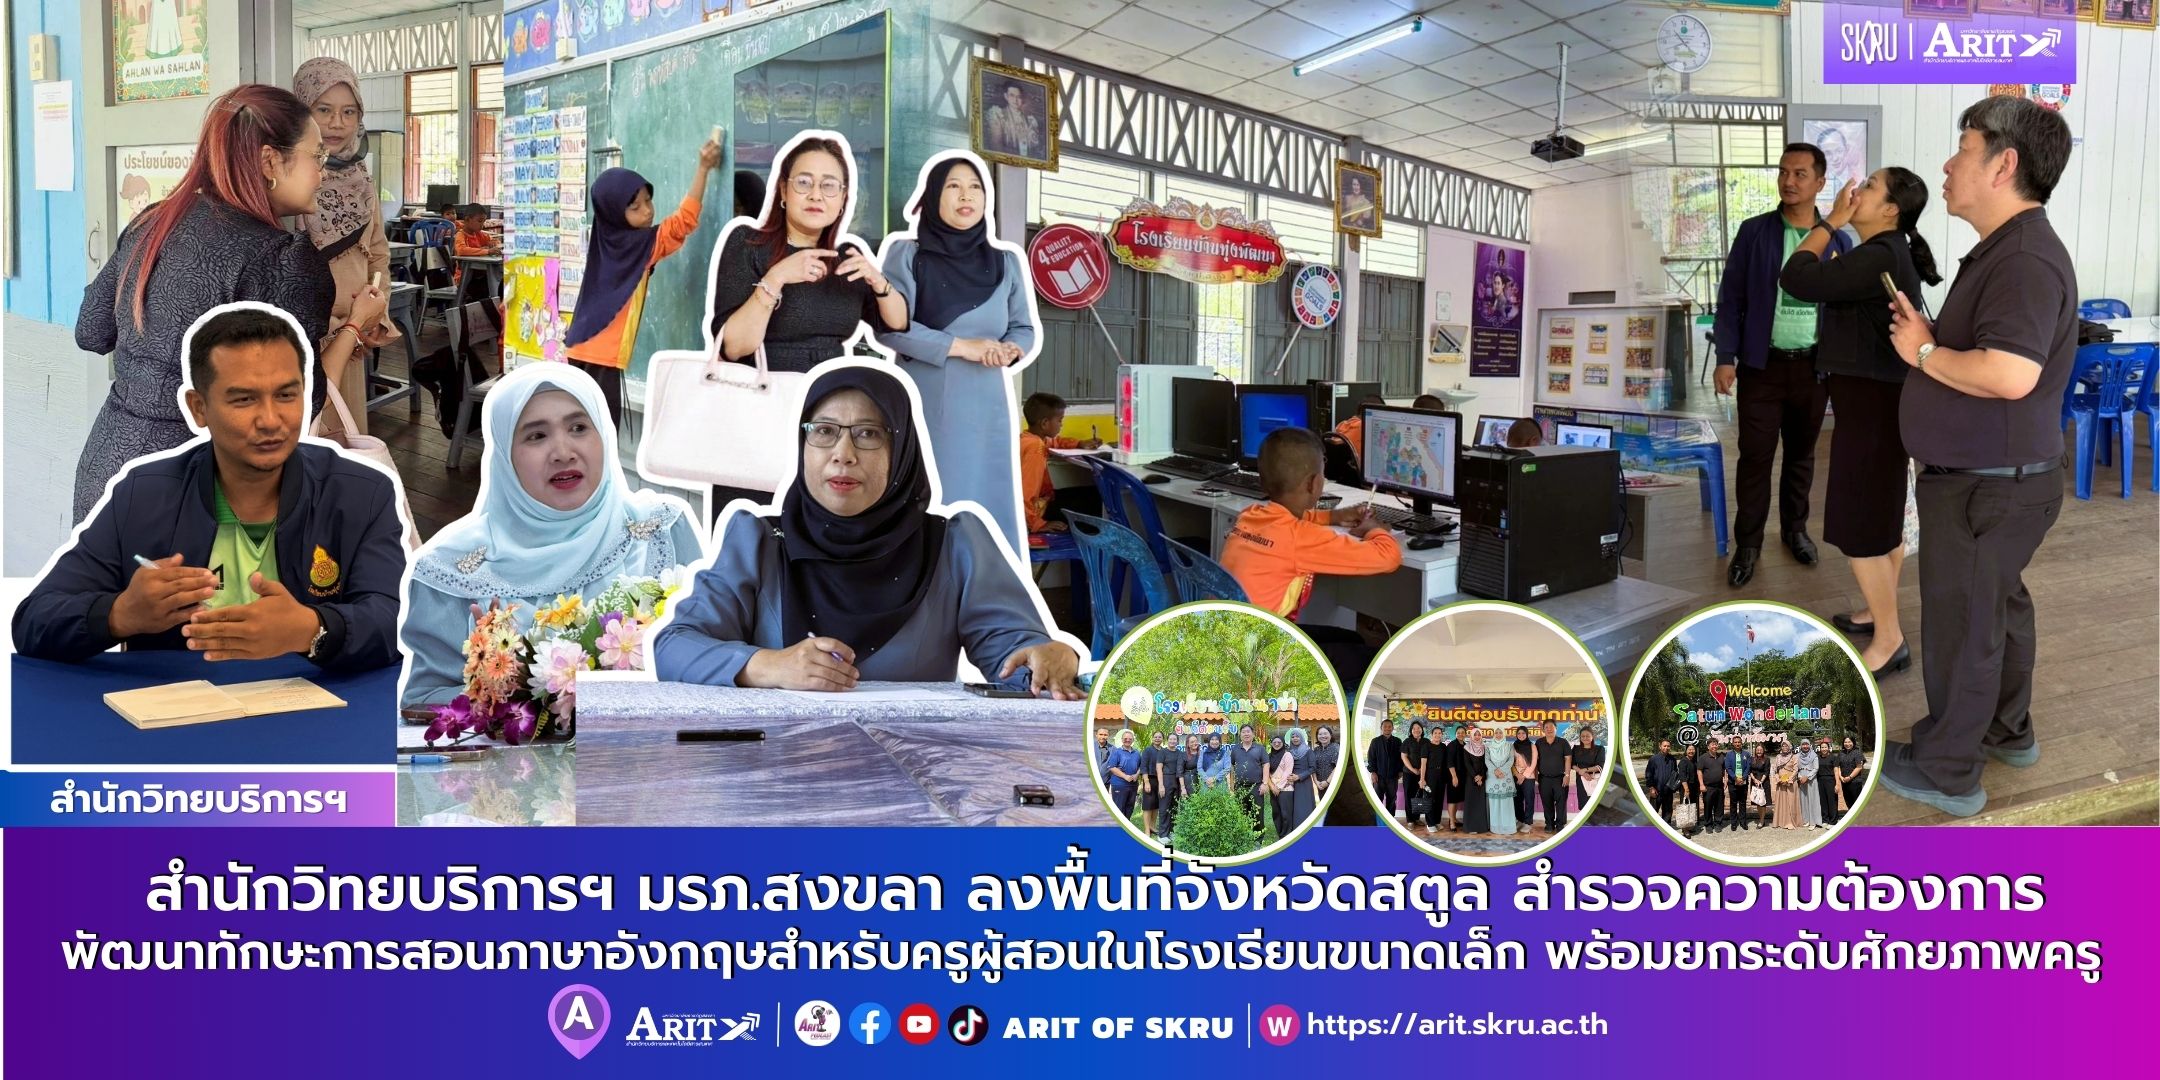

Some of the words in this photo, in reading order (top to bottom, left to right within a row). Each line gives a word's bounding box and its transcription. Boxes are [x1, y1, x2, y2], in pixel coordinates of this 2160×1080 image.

[125, 66, 151, 78] AHLAN
[153, 65, 165, 75] WA
[167, 60, 201, 74] SAHLAN
[514, 164, 531, 180] MAY
[536, 163, 554, 178] JUNE
[1038, 249, 1050, 265] 4
[1045, 235, 1072, 254] QUALITY
[1131, 220, 1275, 264] โรงเรียนบ้านทุ่งพัฒนา
[1049, 241, 1084, 263] EDUCATION
[1728, 684, 1792, 698] Welcome
[1672, 703, 1726, 723] Satun
[1728, 703, 1832, 721] Wonderland
